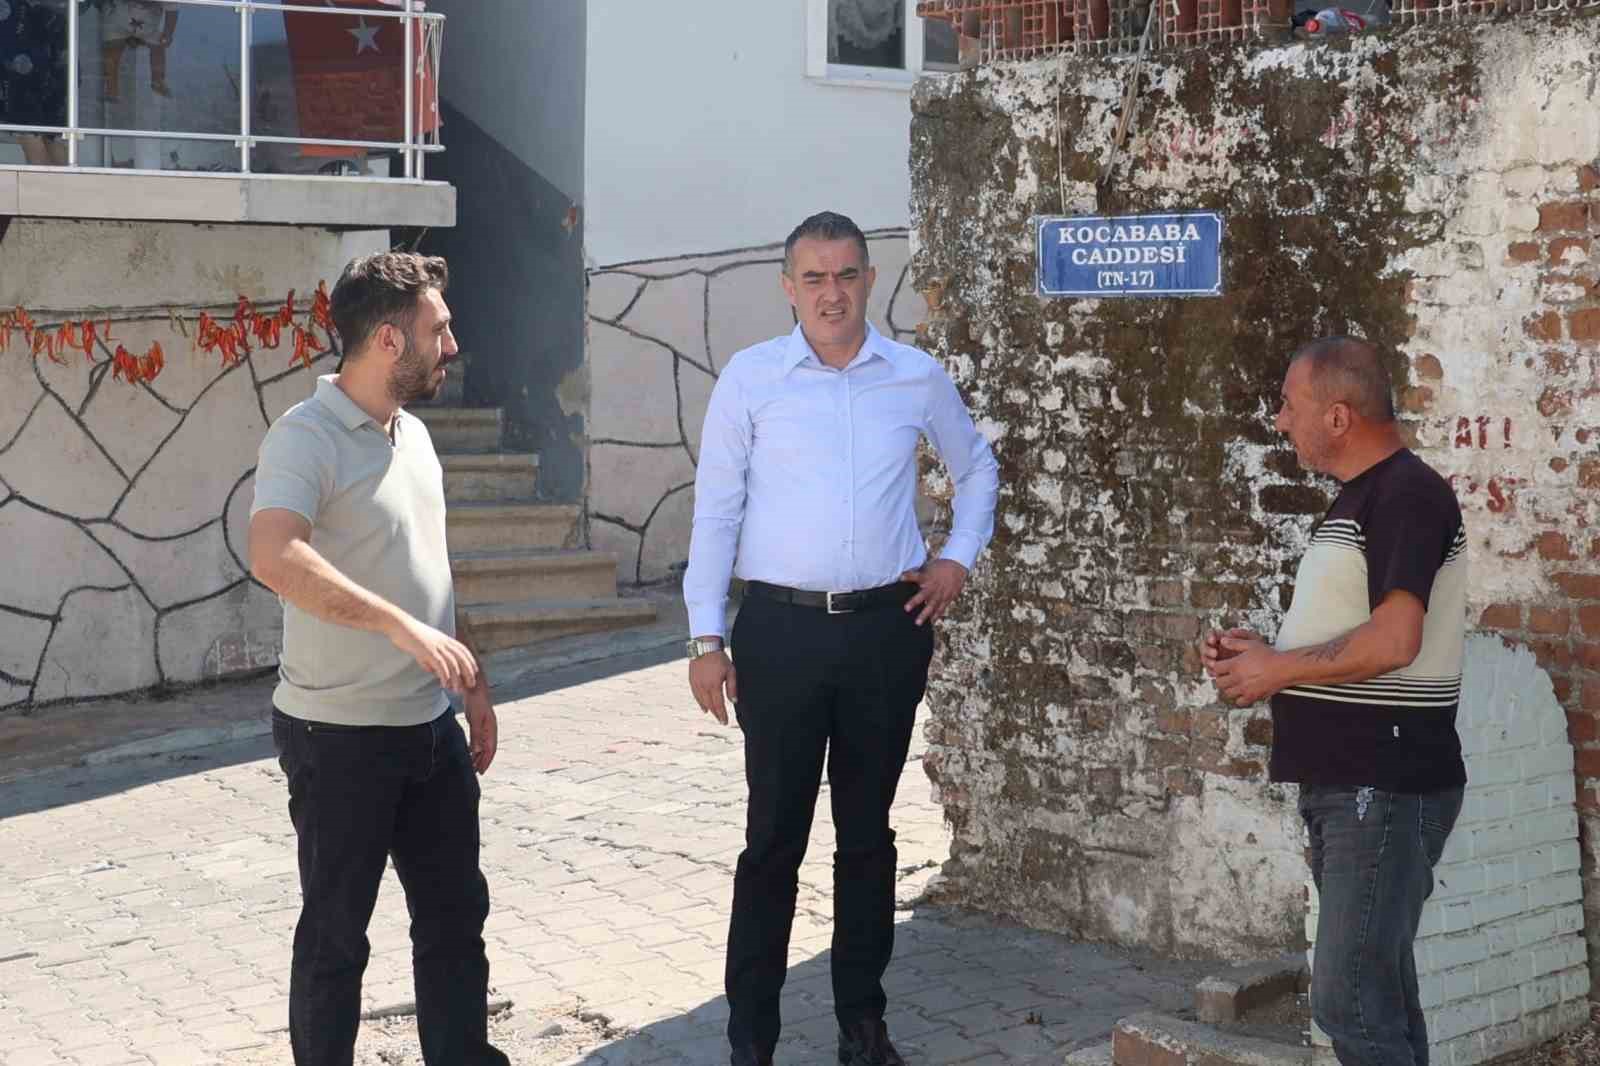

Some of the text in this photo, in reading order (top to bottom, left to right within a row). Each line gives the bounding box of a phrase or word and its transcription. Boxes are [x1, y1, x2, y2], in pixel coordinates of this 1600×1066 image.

[1058, 223, 1200, 244] KOCABABA
[1072, 242, 1186, 265] CADDESİ
[1097, 270, 1154, 289] (TN-17)
